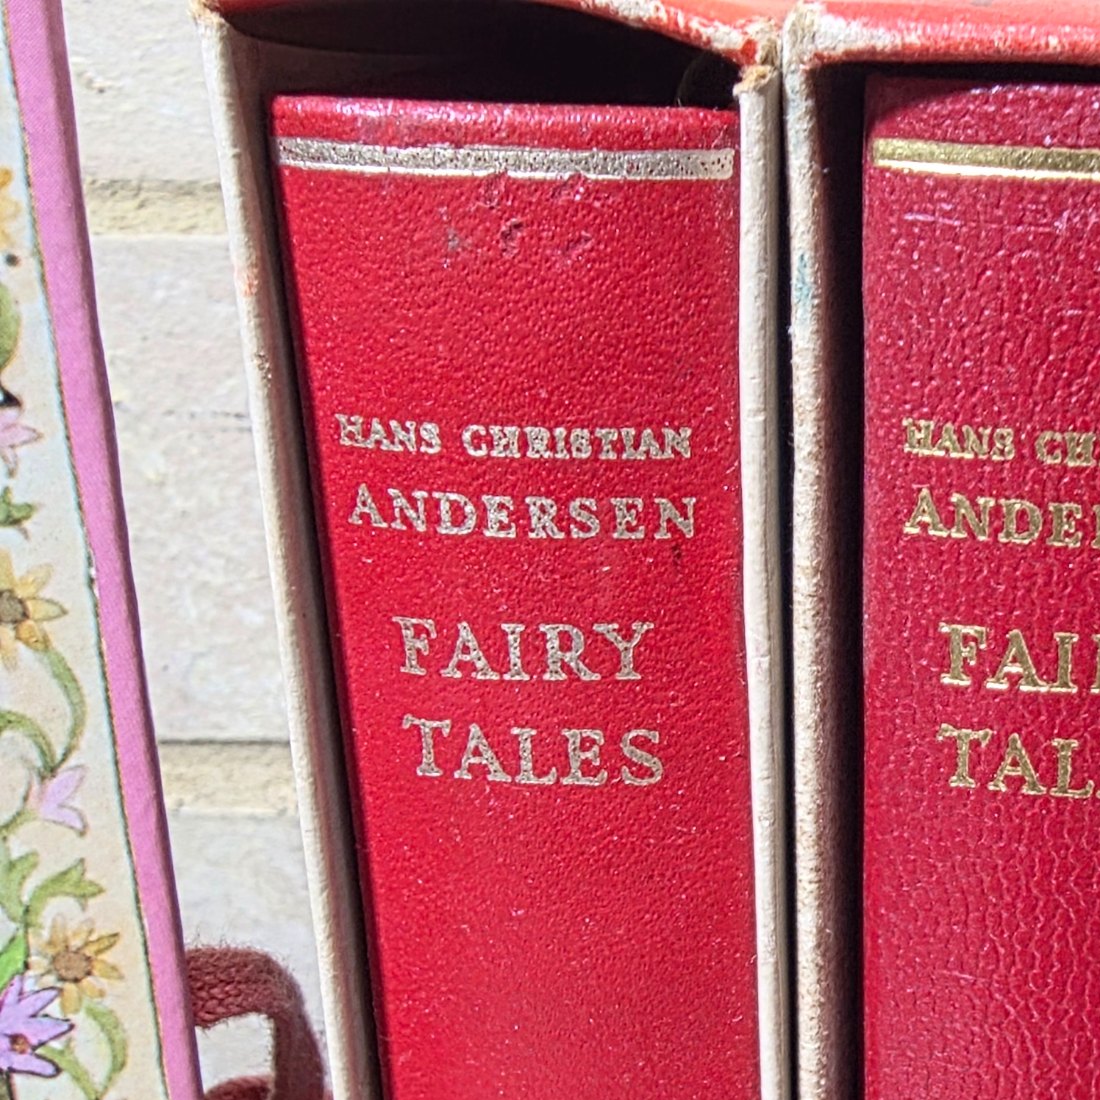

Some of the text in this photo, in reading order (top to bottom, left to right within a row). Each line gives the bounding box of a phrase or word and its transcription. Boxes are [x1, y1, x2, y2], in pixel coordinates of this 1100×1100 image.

[335, 413, 692, 459] HANS CHRISTIAN
[902, 417, 1015, 461] HANS
[348, 483, 697, 540] ANDERSEN
[392, 616, 655, 681] FAIRY
[403, 713, 664, 787] TALES
